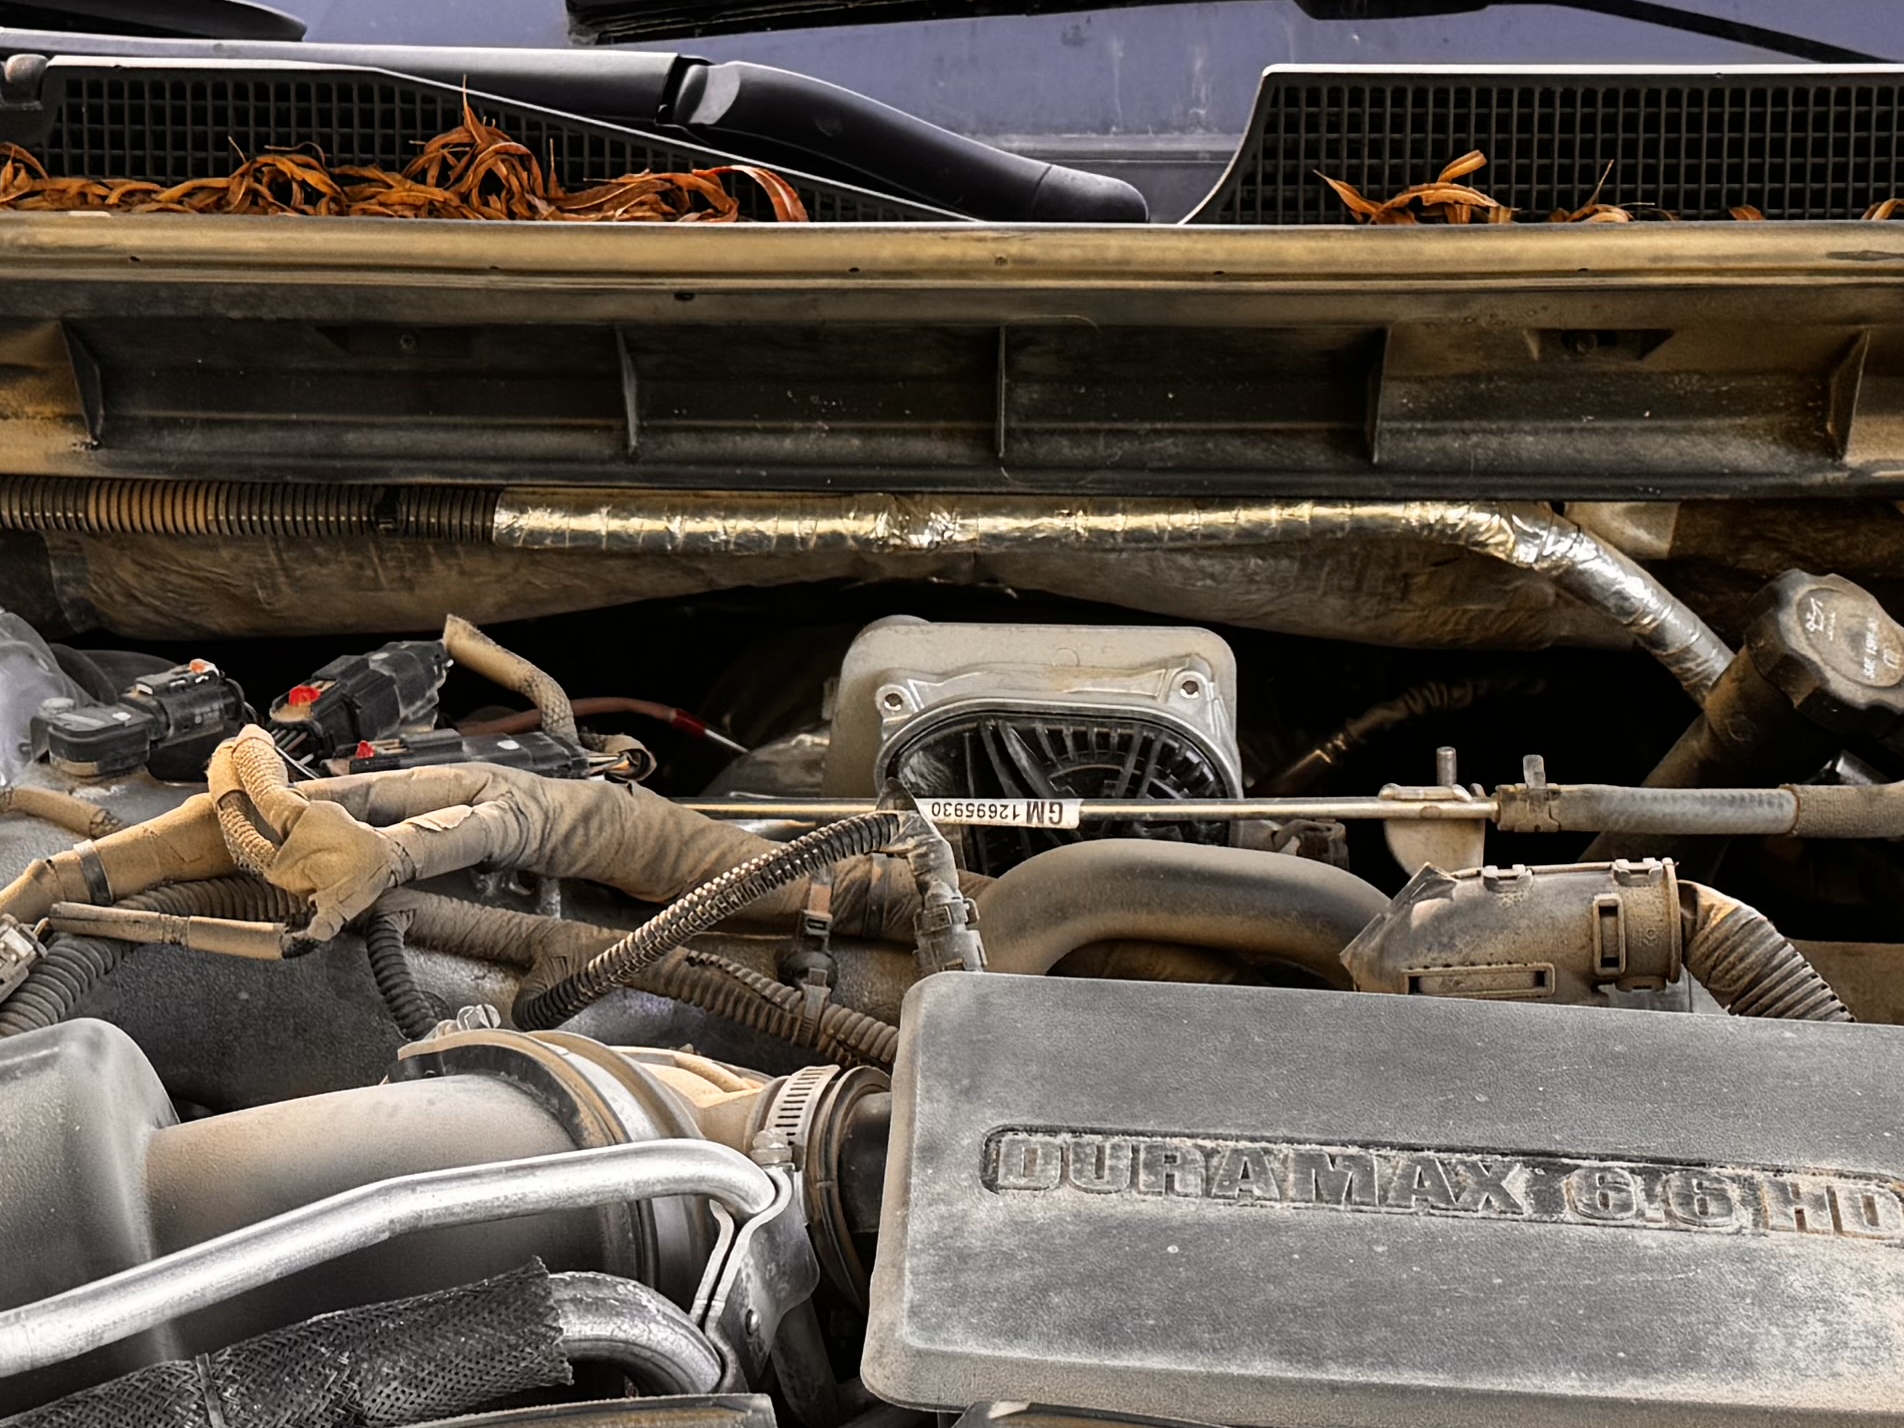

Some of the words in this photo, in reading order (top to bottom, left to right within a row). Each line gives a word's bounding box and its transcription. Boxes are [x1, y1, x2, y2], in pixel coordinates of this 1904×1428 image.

[931, 801, 1021, 821] 12695930
[1026, 800, 1064, 825] GM
[998, 1135, 1527, 1214] DURAMAX
[1563, 1169, 1736, 1230] 6.6
